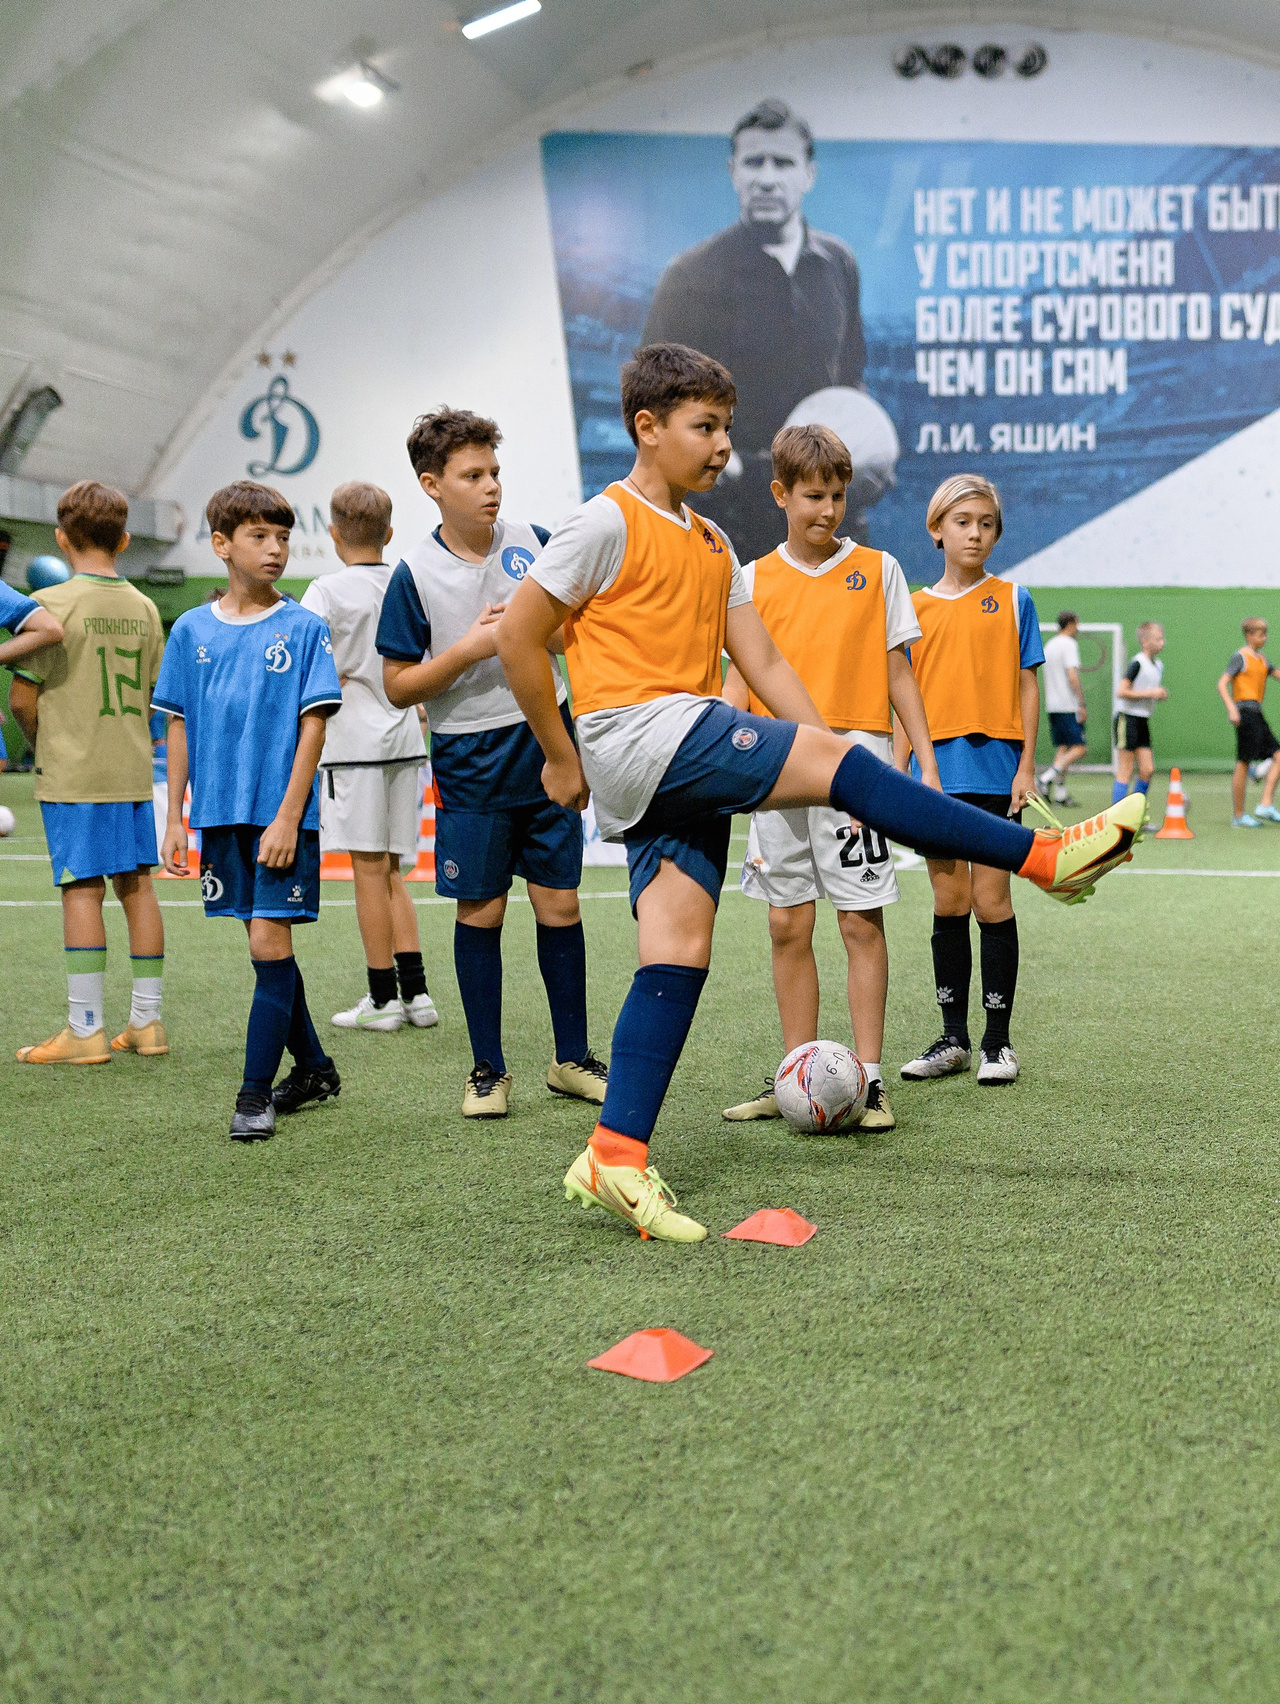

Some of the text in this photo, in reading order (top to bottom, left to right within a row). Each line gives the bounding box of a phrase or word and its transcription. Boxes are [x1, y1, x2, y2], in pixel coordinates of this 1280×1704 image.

[914, 187, 977, 235] НЕТ
[987, 187, 1009, 234] И
[1020, 186, 1063, 233] НЕ
[1073, 185, 1197, 232] МОЖЕТ
[914, 240, 1175, 289] У СПОРТСМЕНА
[915, 294, 1022, 343] БОЛЕЕ
[1031, 293, 1211, 341] СУРОВОГО
[915, 348, 1128, 396] ЧЕМ ОН САМ
[916, 423, 1096, 453] Л.И. ЯШИН
[96, 646, 142, 717] 12
[836, 825, 889, 868] 20
